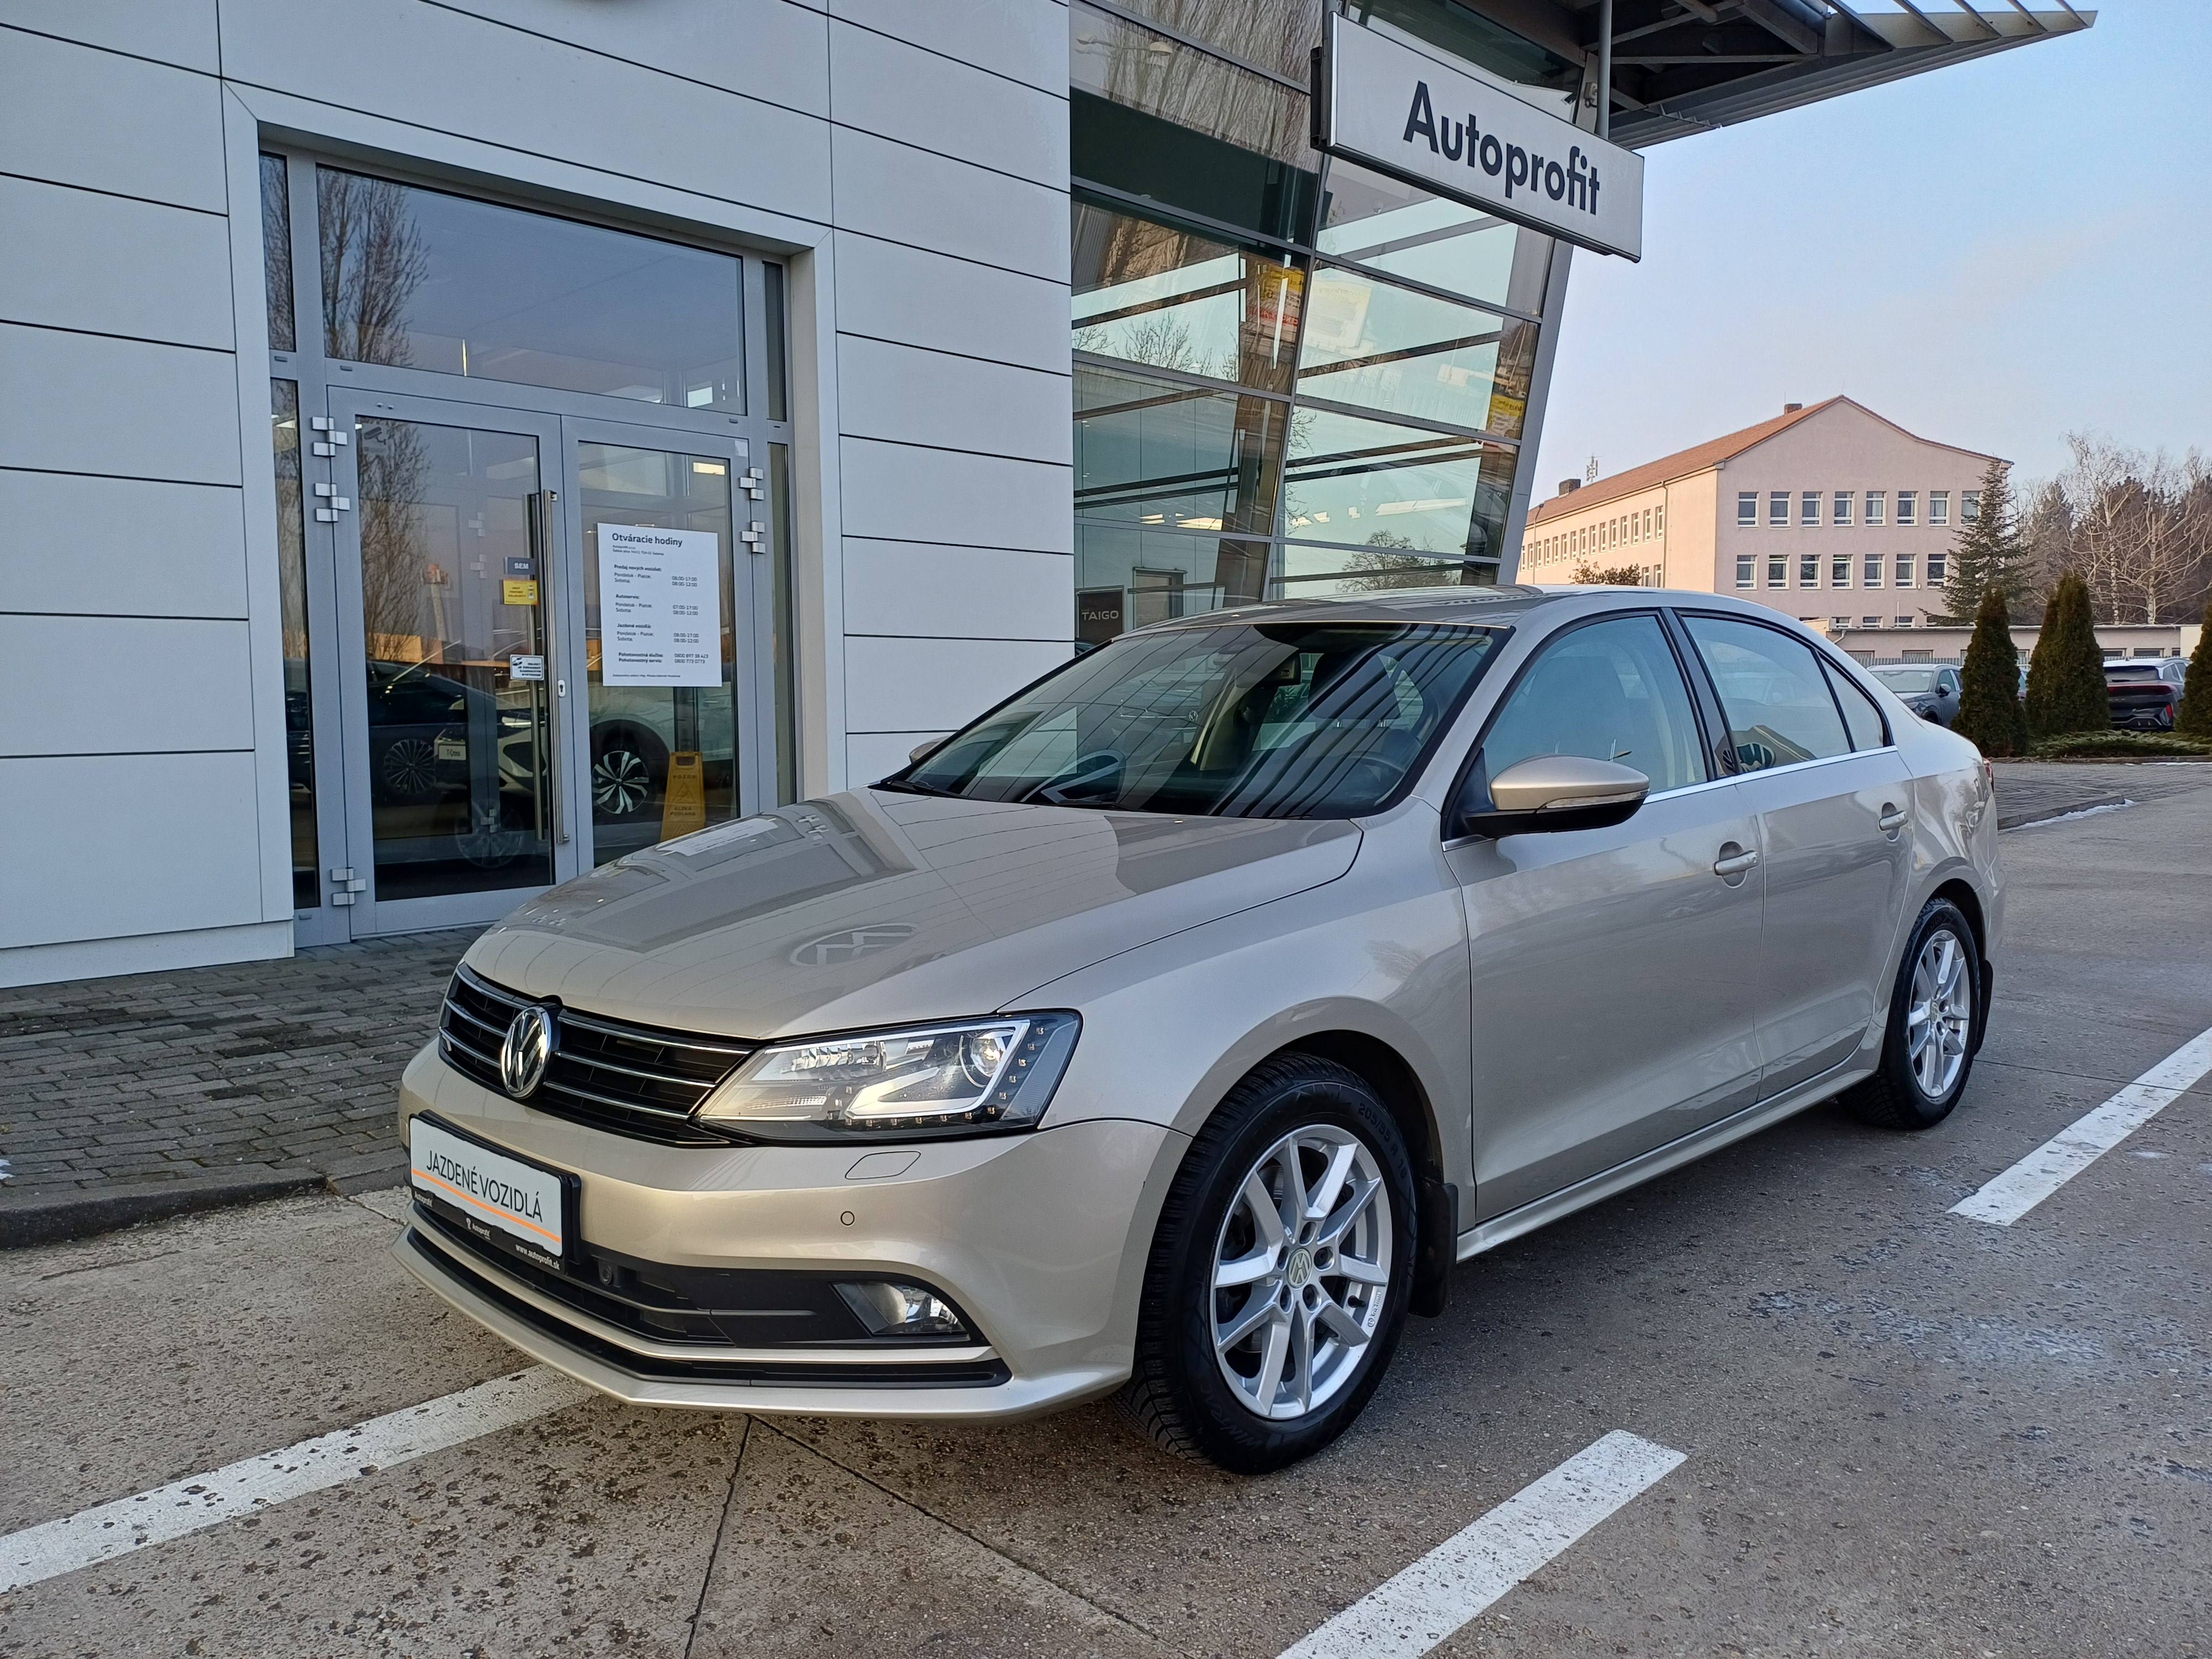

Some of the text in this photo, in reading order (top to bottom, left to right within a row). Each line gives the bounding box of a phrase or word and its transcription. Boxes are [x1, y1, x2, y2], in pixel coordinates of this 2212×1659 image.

[1403, 80, 1600, 216] Autoprofit
[612, 533, 683, 548] Otváracie hodiny
[1081, 610, 1119, 620] TAIGO
[426, 1150, 543, 1223] JAZDENÉ VOZIDLÁ
[515, 1244, 560, 1271] www.autoprofit.sk
